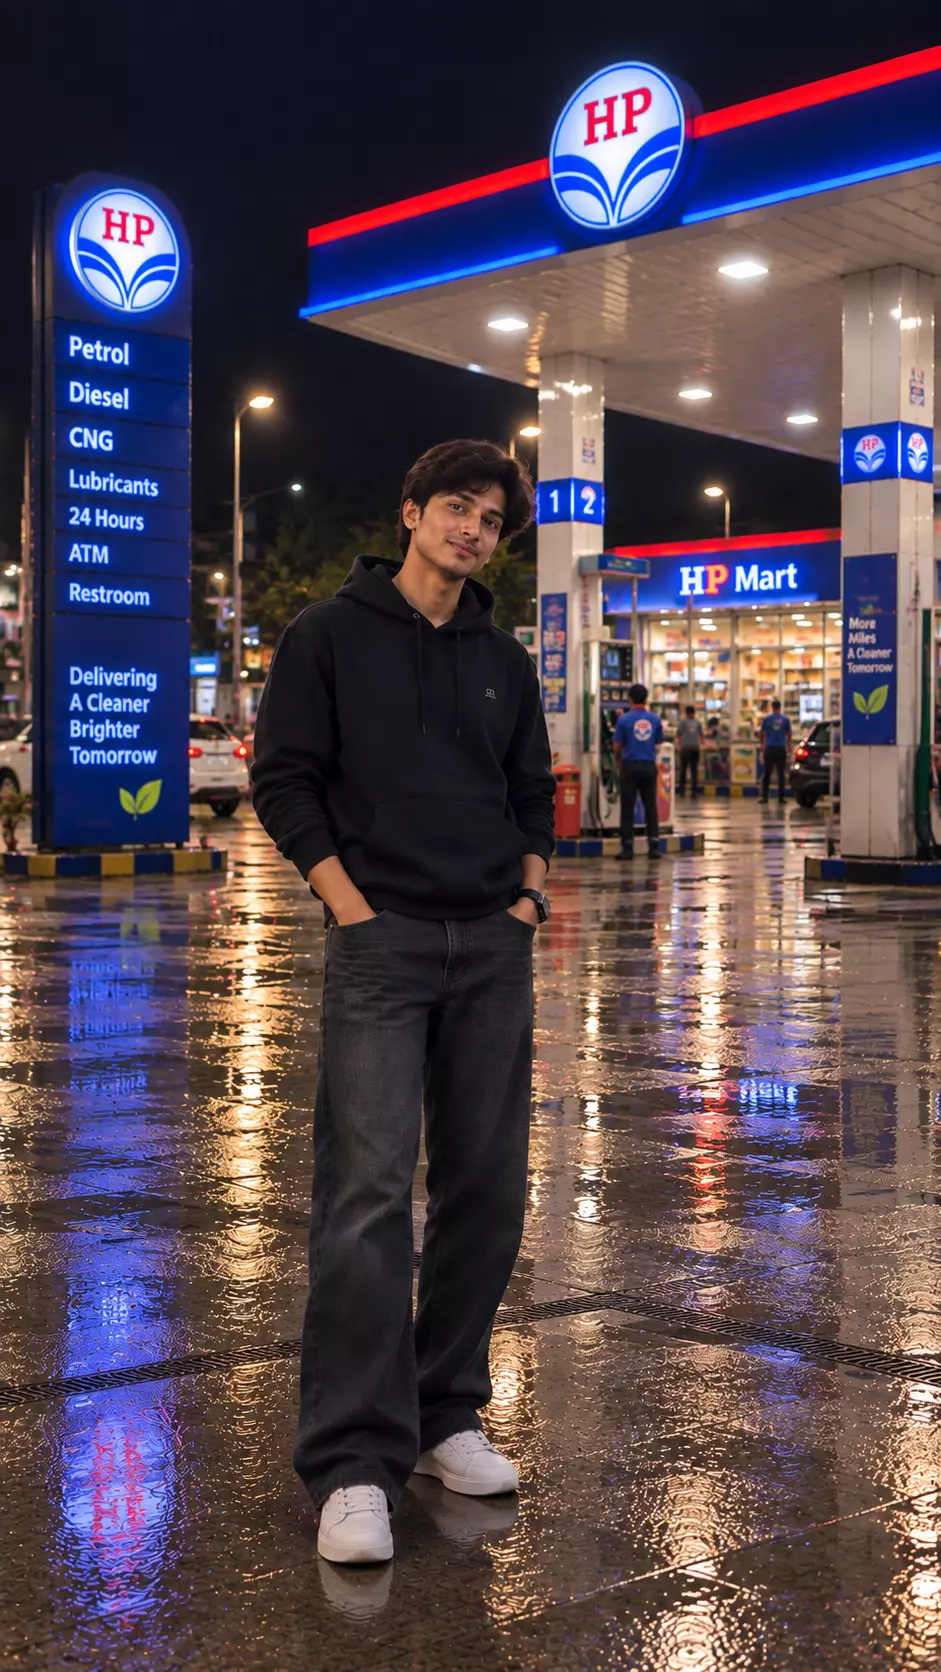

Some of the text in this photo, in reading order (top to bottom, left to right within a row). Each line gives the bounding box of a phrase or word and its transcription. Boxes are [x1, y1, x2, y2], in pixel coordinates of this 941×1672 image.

[584, 87, 652, 147] HP
[102, 206, 155, 247] HP
[69, 335, 129, 366] Petrol
[69, 381, 129, 410] Diesel
[69, 427, 113, 451] CNG
[862, 437, 879, 451] HP
[69, 469, 159, 497] Lubricants
[549, 489, 559, 514] 1
[580, 486, 597, 515] 2
[69, 506, 145, 531] 24 Hours
[69, 543, 109, 564] ATM
[679, 563, 798, 596] HP Mart
[69, 583, 150, 606] Restroom
[848, 617, 877, 630] More
[848, 631, 877, 645] Miles
[847, 647, 855, 660] A
[69, 666, 157, 692] Delivering
[846, 662, 894, 674] Tomorrow
[69, 692, 150, 713] A Cleaner
[70, 719, 140, 743] Brighter
[69, 746, 157, 765] Tomorrow
